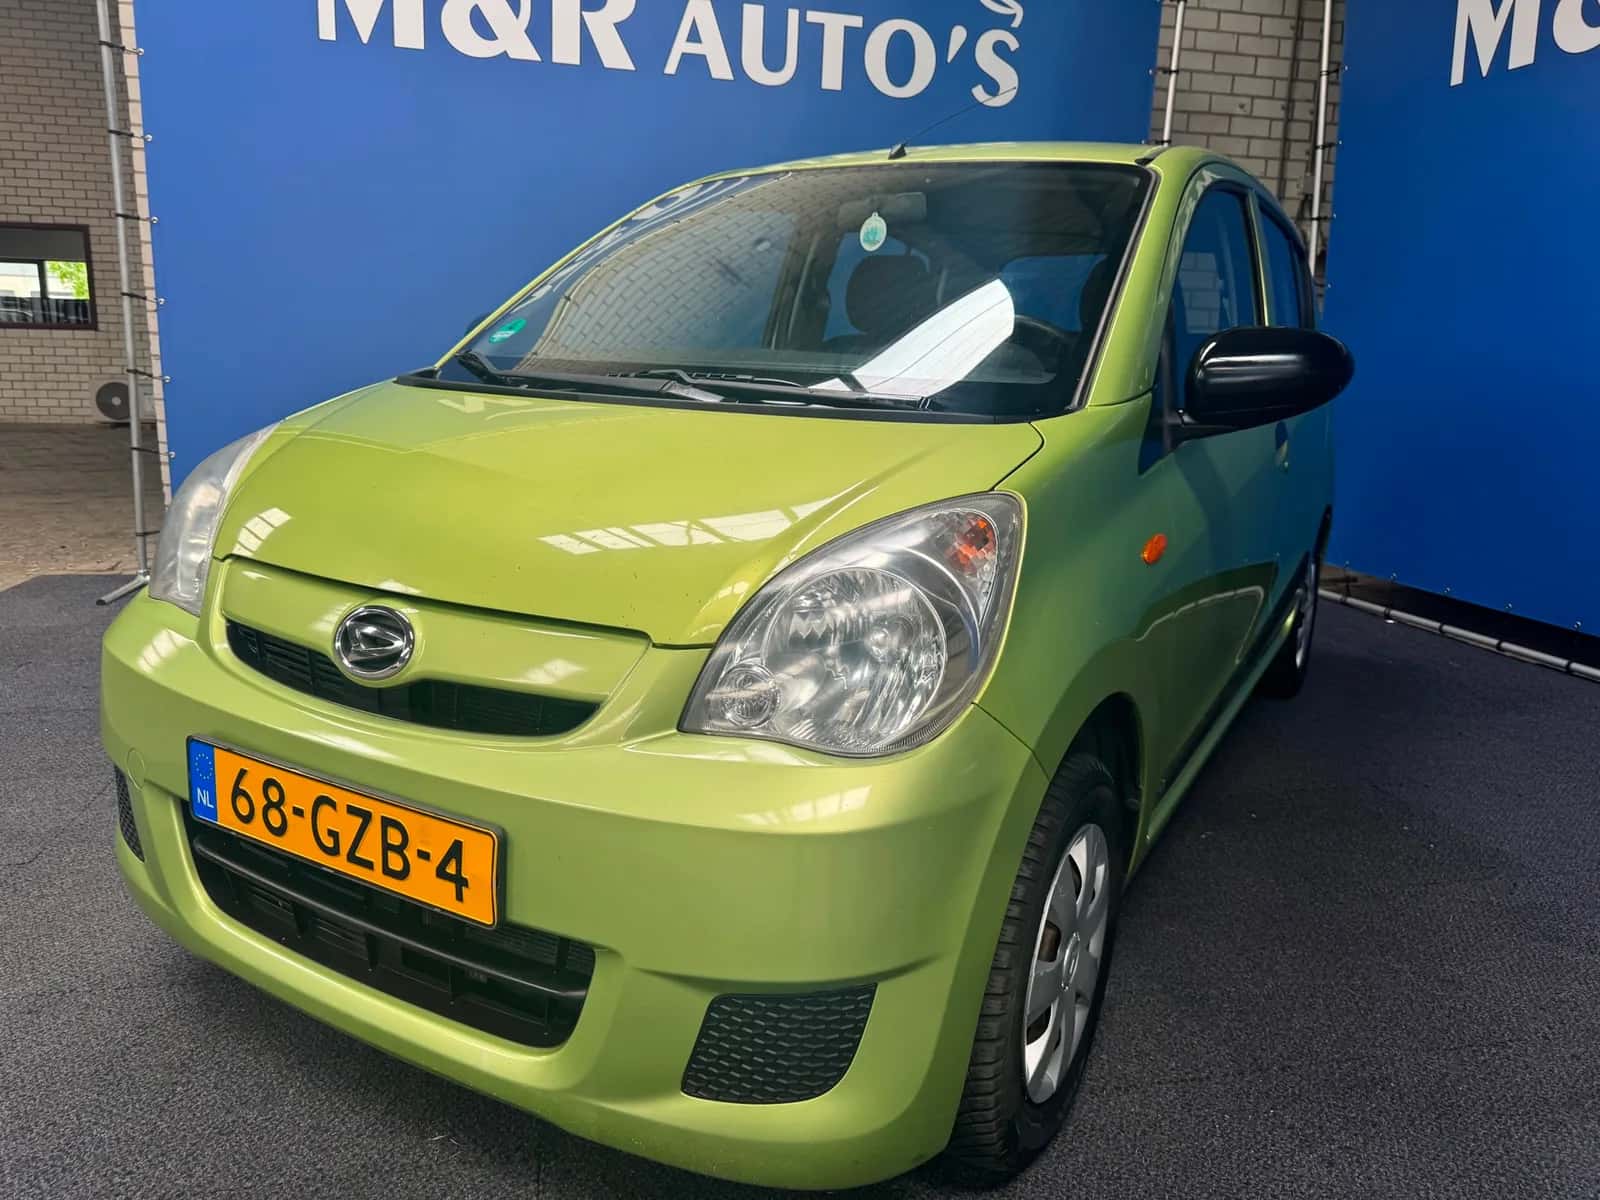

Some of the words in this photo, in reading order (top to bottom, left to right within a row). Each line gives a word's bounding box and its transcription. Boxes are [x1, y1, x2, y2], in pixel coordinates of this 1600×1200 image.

[663, 0, 1021, 107] AUTO'S
[197, 786, 214, 809] NL
[231, 768, 469, 903] 68-GZB-4
